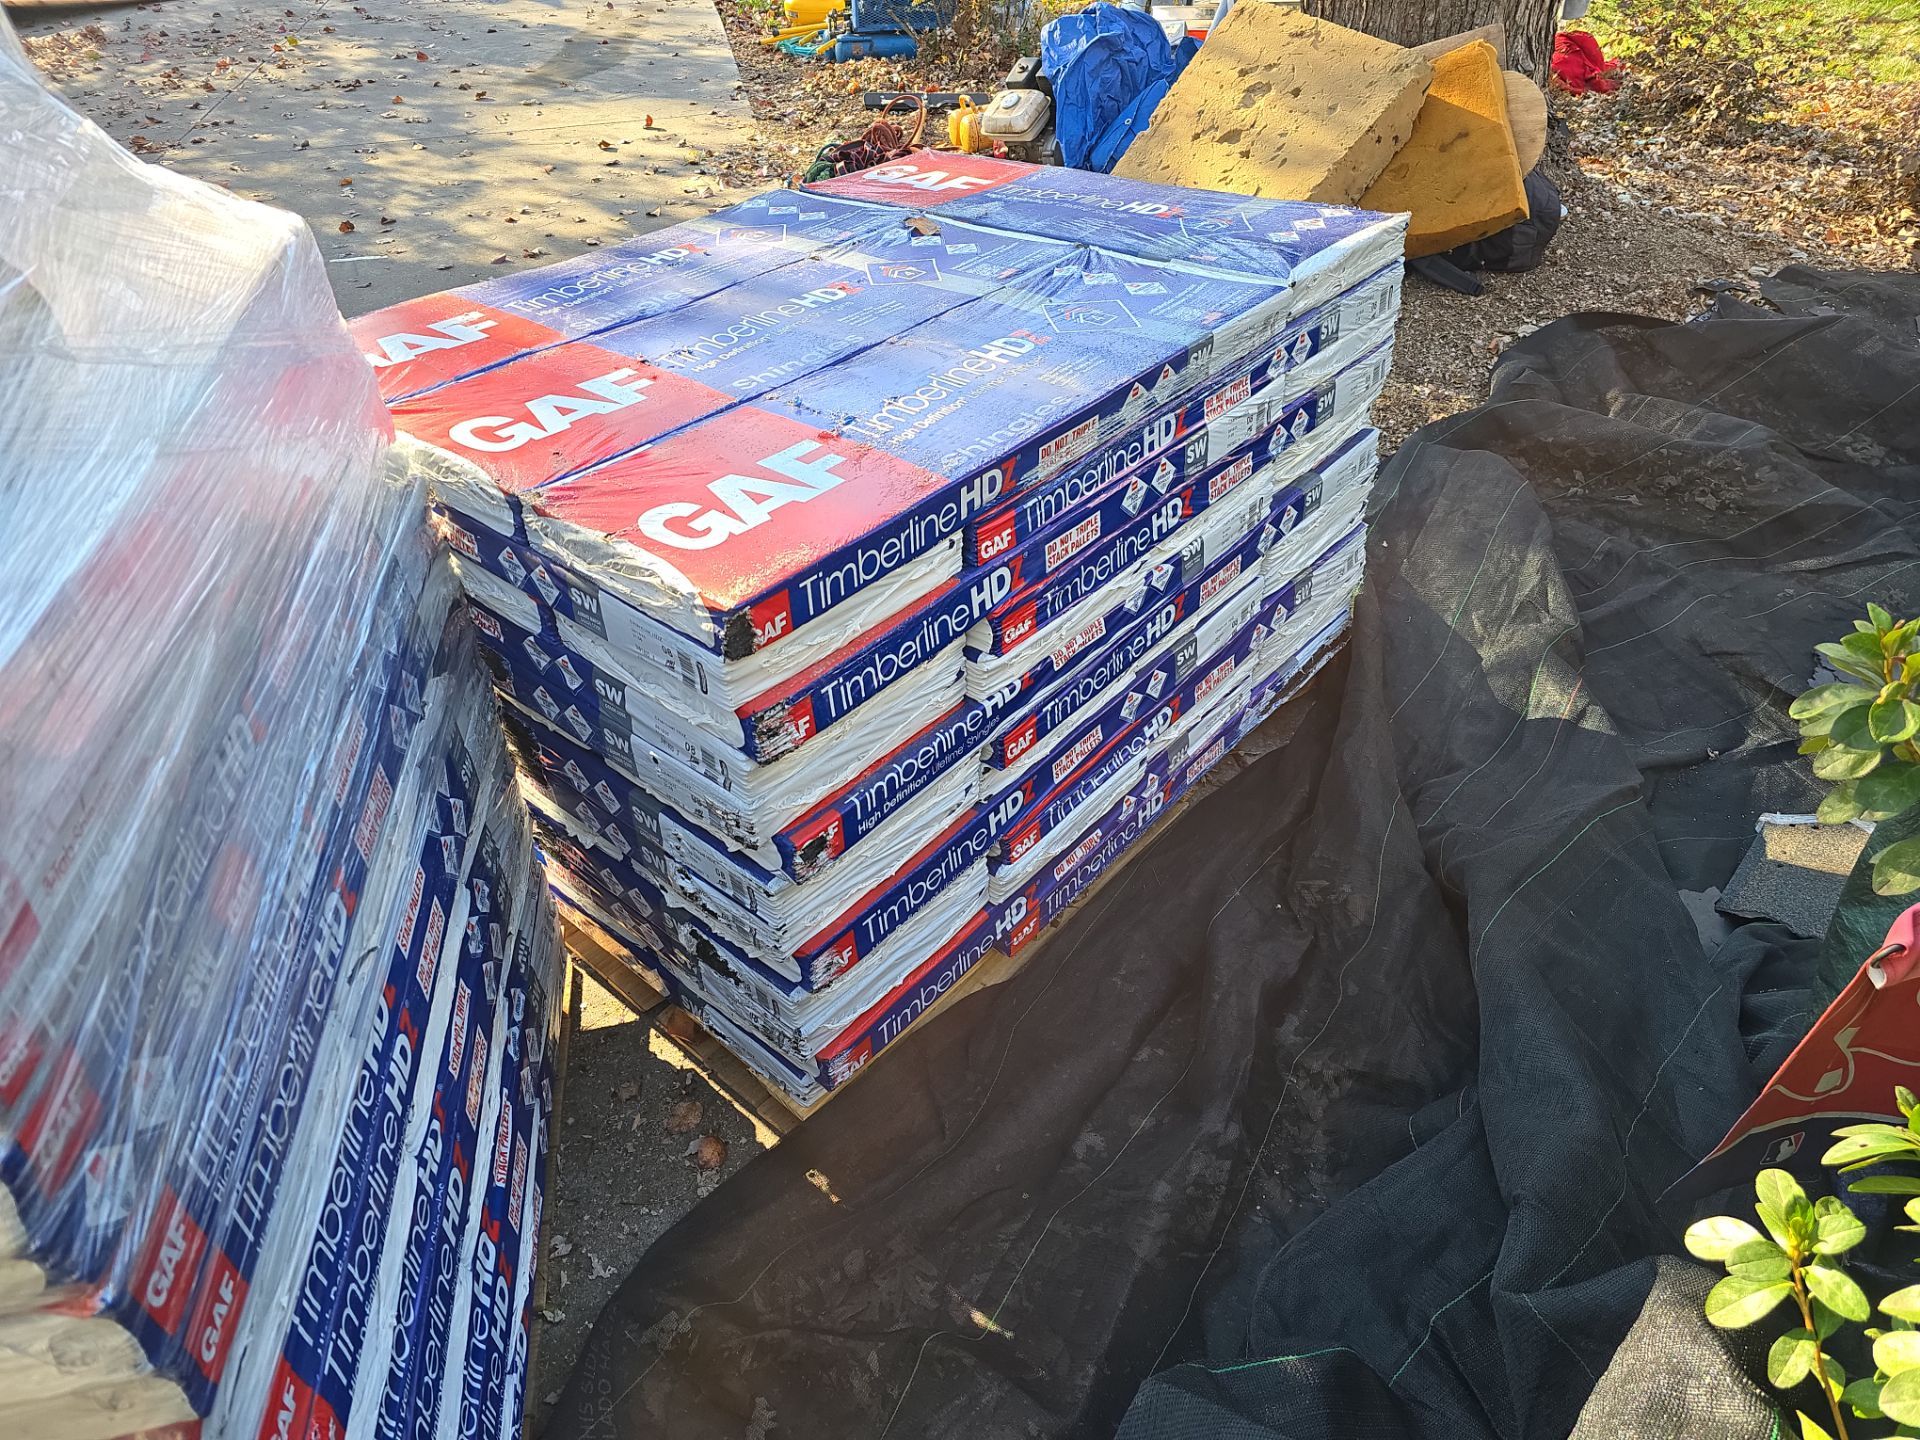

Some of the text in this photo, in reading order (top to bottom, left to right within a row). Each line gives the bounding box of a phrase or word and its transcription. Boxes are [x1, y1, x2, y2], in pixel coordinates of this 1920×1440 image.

[863, 165, 995, 192] GAF
[364, 310, 499, 368] AF
[658, 281, 866, 368] TimberlineHDZ
[1321, 312, 1340, 341] SW
[843, 329, 1053, 437] TimberlineHDZ
[1229, 376, 1249, 398] TRIPLE
[1317, 389, 1335, 415] SW
[449, 367, 656, 453] GAF
[1023, 405, 1189, 533] TimberlineHDZ
[1041, 444, 1053, 461] DO
[1054, 435, 1070, 455] NOT
[1186, 436, 1208, 465] SW
[1233, 457, 1252, 478] TRIPLE
[637, 439, 848, 550] GAF
[1210, 465, 1252, 501] STACK PALLETS
[1305, 483, 1322, 505] SW
[799, 456, 1019, 617] TimberlineHDZ
[981, 529, 1012, 560] GAF
[1043, 487, 1193, 618] TimberlineHDZ
[1047, 515, 1099, 555] DO NOT TRIPLE
[1048, 526, 1099, 574] STACK PALLETS
[1182, 536, 1202, 562] SW
[1218, 568, 1241, 592] PALLETS
[1222, 557, 1241, 578] TRIPLE
[570, 587, 597, 614] SW
[821, 554, 1026, 718] TimberlineHDZ
[1003, 617, 1033, 645] GAF
[1053, 650, 1064, 662] DO
[1079, 620, 1103, 644] TRIPLE
[1043, 592, 1185, 730] TimberlineHDZ
[1176, 642, 1196, 666] SW
[594, 678, 622, 706] SW
[603, 727, 629, 754] SW
[788, 713, 811, 740] AF
[846, 670, 1034, 821] TimberlineHDZ
[1006, 729, 1034, 760] GAF
[684, 742, 696, 756] 08
[1054, 728, 1101, 771] DO NOT TRIPLE
[1055, 735, 1102, 779] STACK PALLETS
[460, 753, 474, 790] SW
[857, 810, 881, 836] High
[883, 774, 927, 812] Definition
[965, 714, 1001, 747] Shingles
[631, 805, 658, 834] SW
[641, 845, 668, 875] SW
[862, 780, 1036, 944] TimberlineHDZ
[1045, 780, 1173, 916] TimberlineHDZ
[1055, 832, 1101, 876] DO NOT TRIPLE
[400, 867, 424, 953] STACK PALLETS
[423, 938, 432, 958] NOT
[429, 902, 439, 935] TRIPLE
[422, 911, 444, 995] STACK PALLETS
[878, 883, 1039, 1045] TimberlineHDZ
[496, 1104, 511, 1184] STACK PALLETS
[324, 1007, 419, 1387] TimberlineHDZ
[147, 1212, 188, 1310] GAF
[375, 1089, 447, 1440] imberlineHDZ
[201, 1269, 236, 1364] GAF
[272, 1375, 298, 1440] AF
